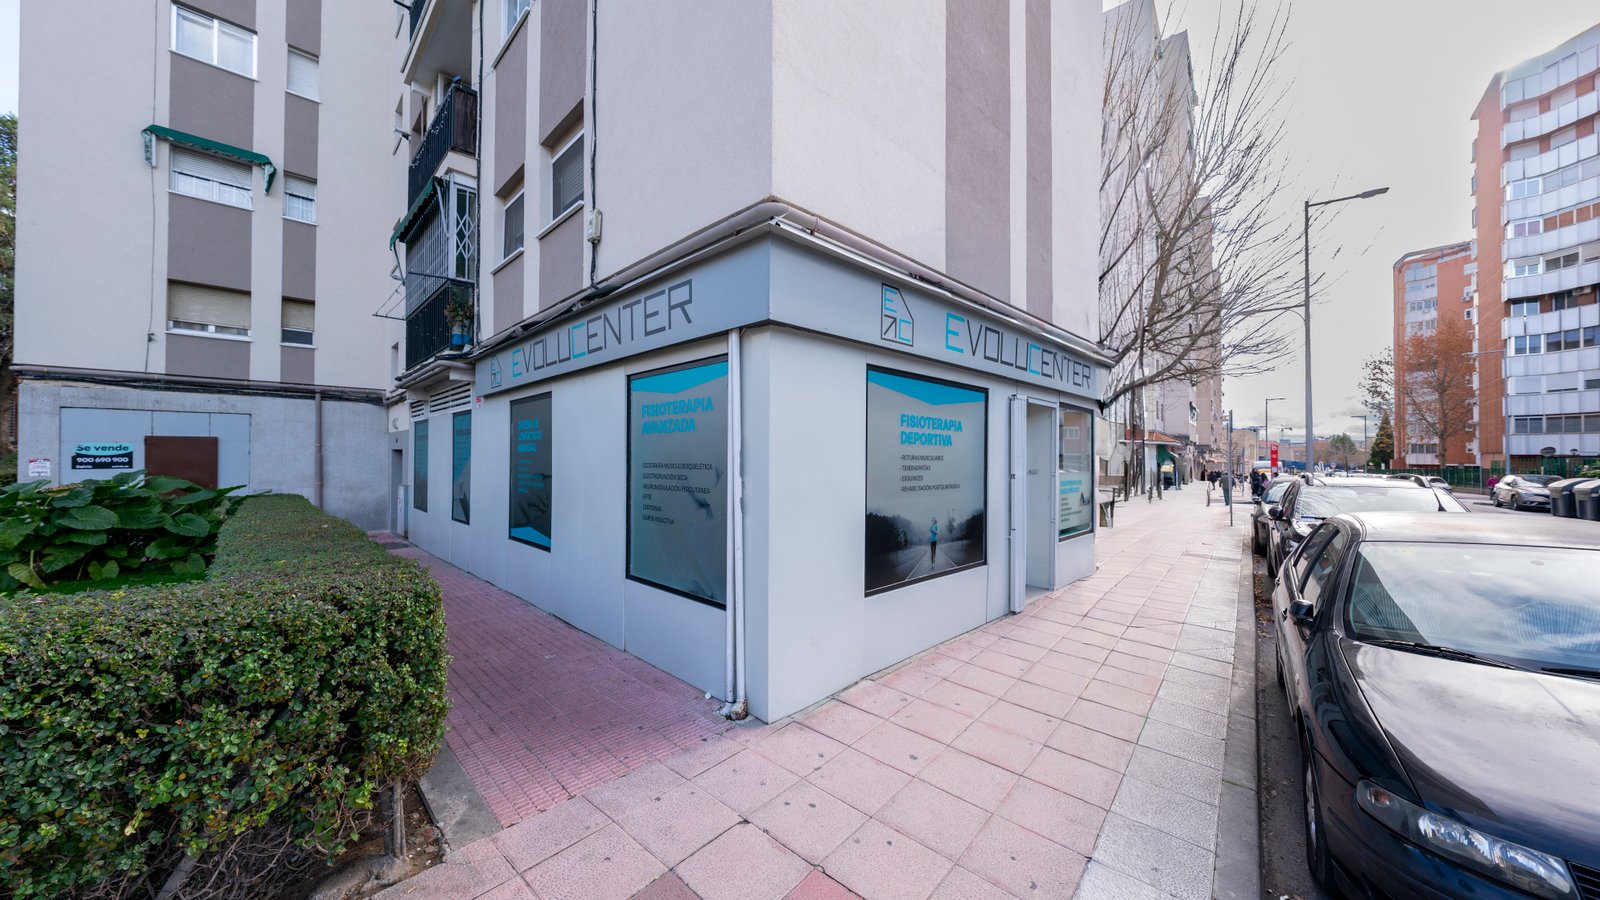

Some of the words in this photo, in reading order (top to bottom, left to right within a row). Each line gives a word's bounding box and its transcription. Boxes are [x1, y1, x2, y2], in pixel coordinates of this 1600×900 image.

[512, 278, 693, 378] EVOLUCENTER
[945, 312, 1091, 389] EVOLUCENTER
[641, 395, 714, 418] FISIOTERAPIA
[641, 417, 697, 435] AVANZADA
[900, 413, 963, 432] FISIOTERAPIA
[76, 444, 91, 452] Se
[94, 444, 129, 452] vende
[900, 430, 953, 447] DEPORTIVA
